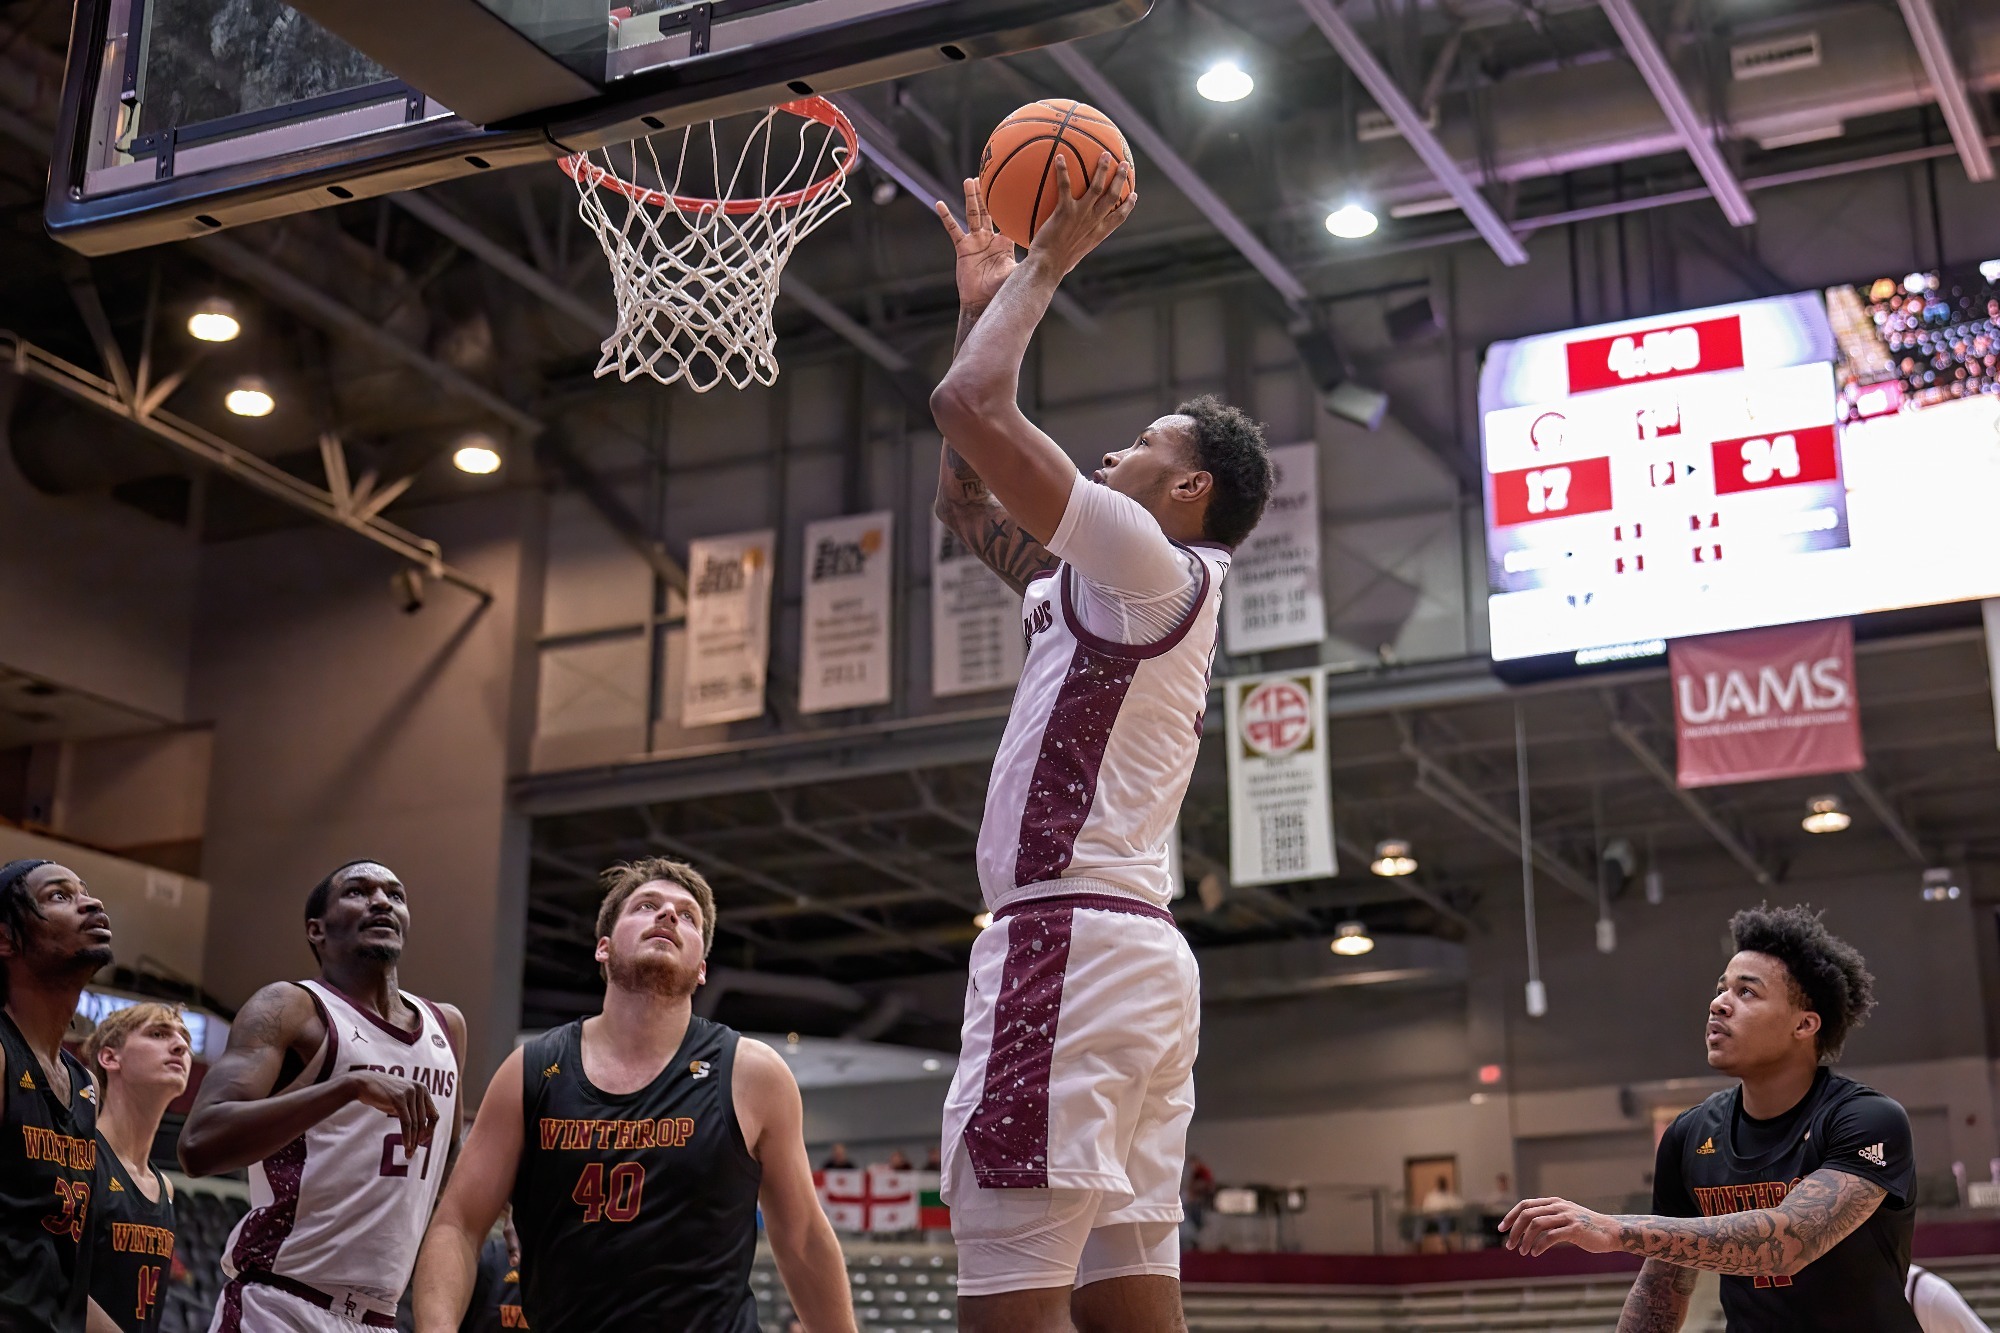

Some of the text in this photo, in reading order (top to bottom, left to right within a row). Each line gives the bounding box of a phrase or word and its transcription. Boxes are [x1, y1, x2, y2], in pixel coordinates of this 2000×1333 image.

[1741, 434, 1800, 483] 34
[1525, 466, 1571, 514] 17
[1679, 656, 1849, 724] UAMS
[540, 1117, 695, 1150] WINTHROP
[1858, 1149, 1887, 1167] adidas
[41, 1176, 91, 1243] 33
[572, 1161, 646, 1223] 40
